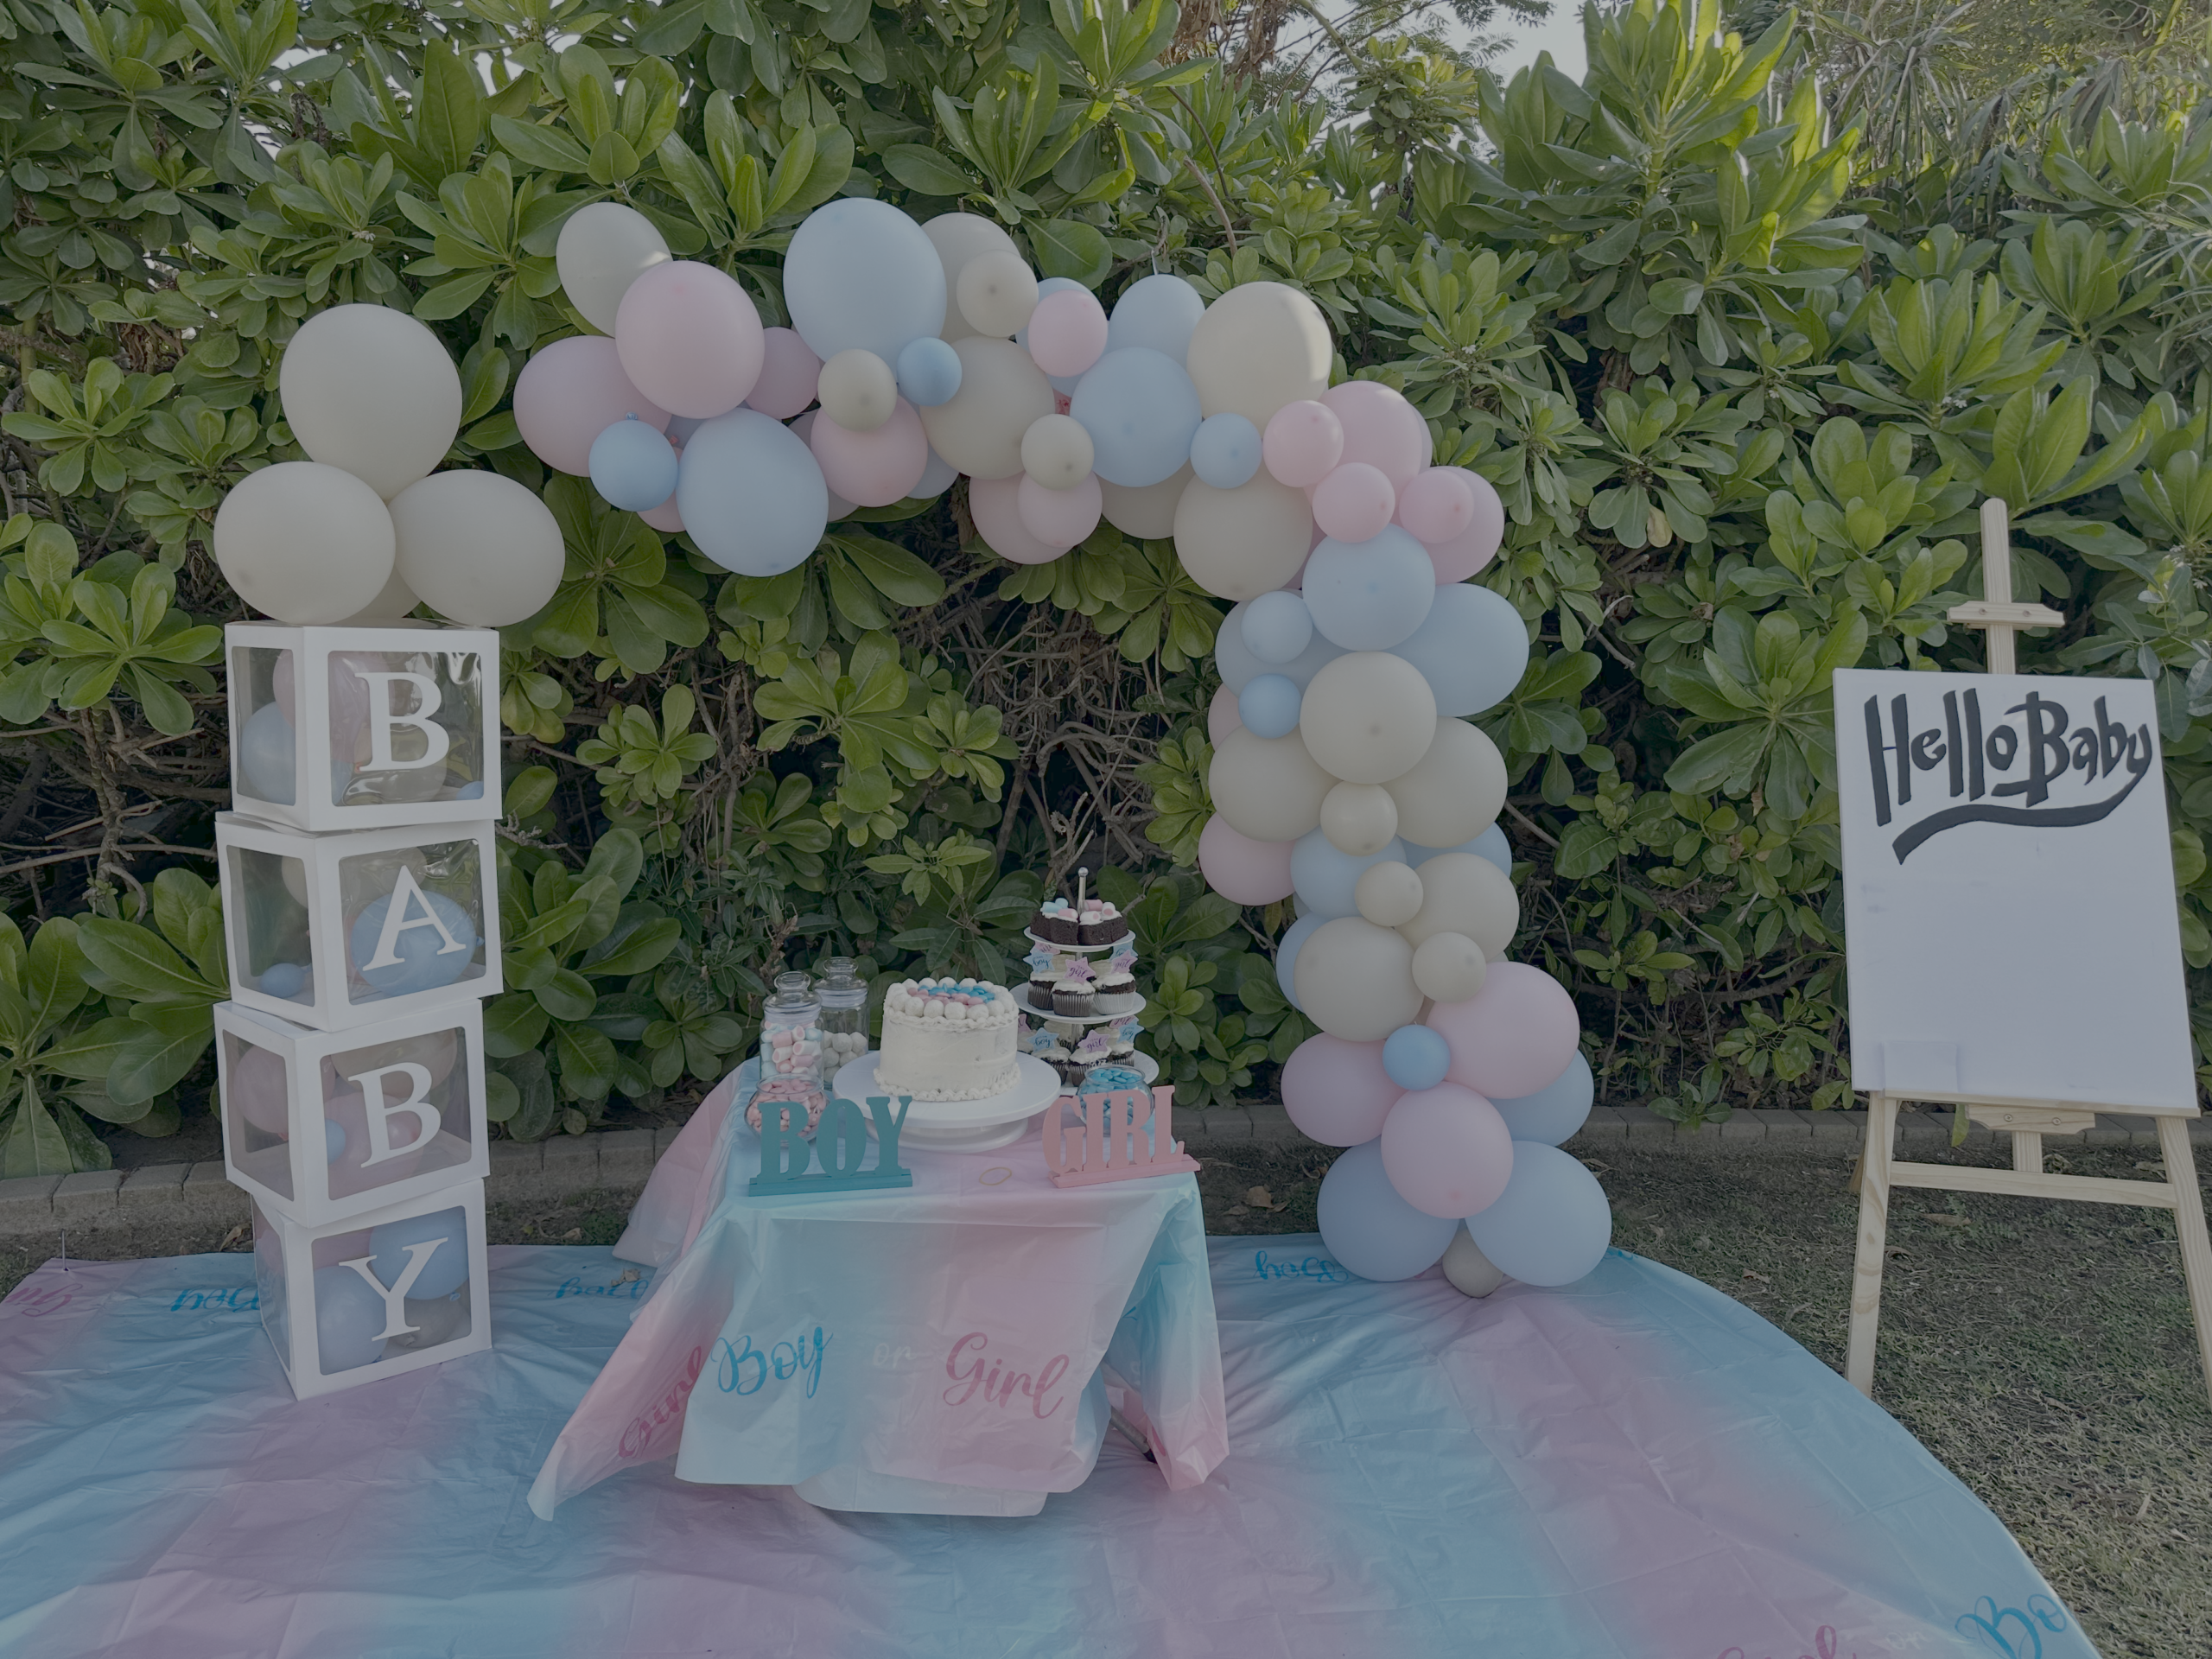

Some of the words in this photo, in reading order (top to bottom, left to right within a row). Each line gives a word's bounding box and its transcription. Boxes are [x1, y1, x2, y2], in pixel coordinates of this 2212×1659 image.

[1864, 688, 2018, 827] Hello
[1987, 691, 2152, 831] Baby
[1032, 957, 1052, 969] boy
[1115, 958, 1132, 971] girl
[1069, 966, 1089, 978] girl
[1033, 1037, 1052, 1049] boy
[1085, 1037, 1105, 1052] girl
[1042, 1085, 1185, 1176] GIRL
[757, 1096, 913, 1185] BOY
[710, 1326, 834, 1399] Boy
[943, 1332, 1070, 1420] Girl
